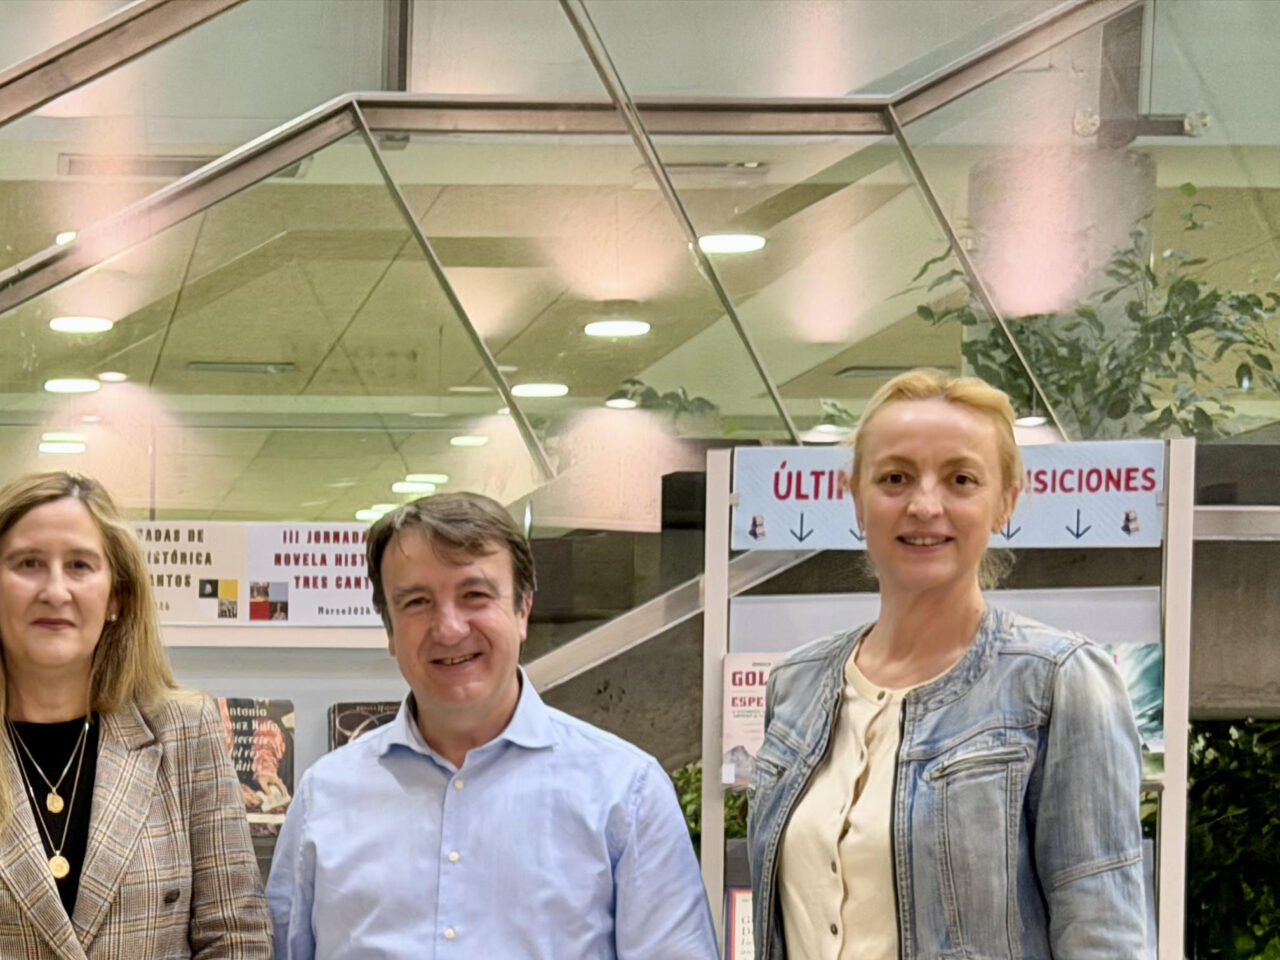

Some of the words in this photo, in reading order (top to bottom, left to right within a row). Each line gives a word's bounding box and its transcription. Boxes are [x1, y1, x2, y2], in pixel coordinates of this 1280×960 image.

[188, 529, 204, 543] DE
[283, 530, 299, 543] III
[274, 553, 327, 566] NOVELA
[294, 576, 328, 590] TRES
